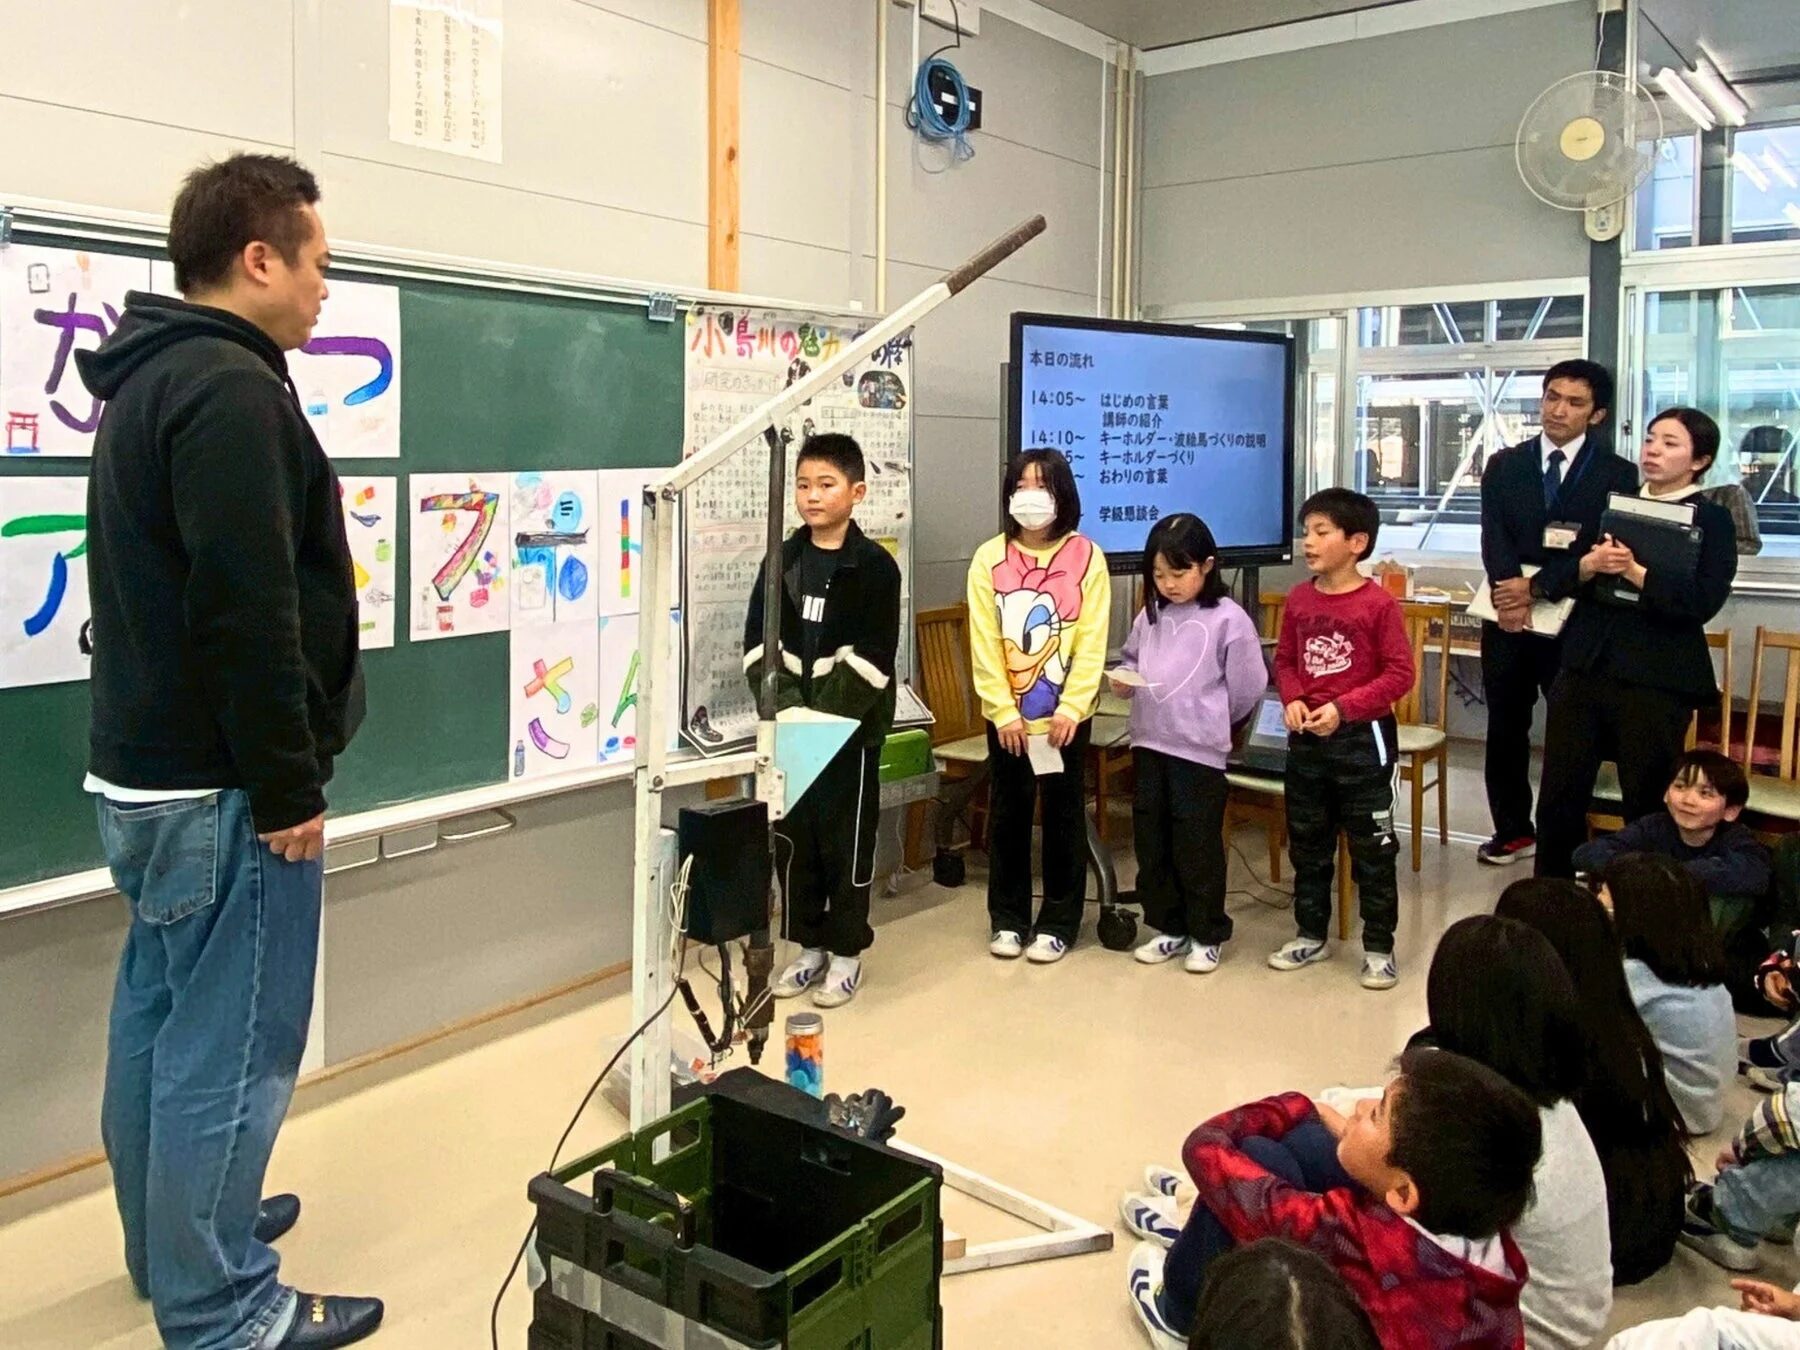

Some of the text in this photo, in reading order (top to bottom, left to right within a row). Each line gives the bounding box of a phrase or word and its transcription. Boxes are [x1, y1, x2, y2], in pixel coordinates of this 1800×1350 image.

[1029, 351, 1095, 369] 本日の流れ
[1100, 393, 1169, 410] はじめの言葉
[1102, 412, 1163, 429] 講師の紹介
[1099, 448, 1195, 465] キーホルダーづくり
[1099, 468, 1168, 485] おわりの言葉
[1099, 504, 1160, 522] 学級懇談会
